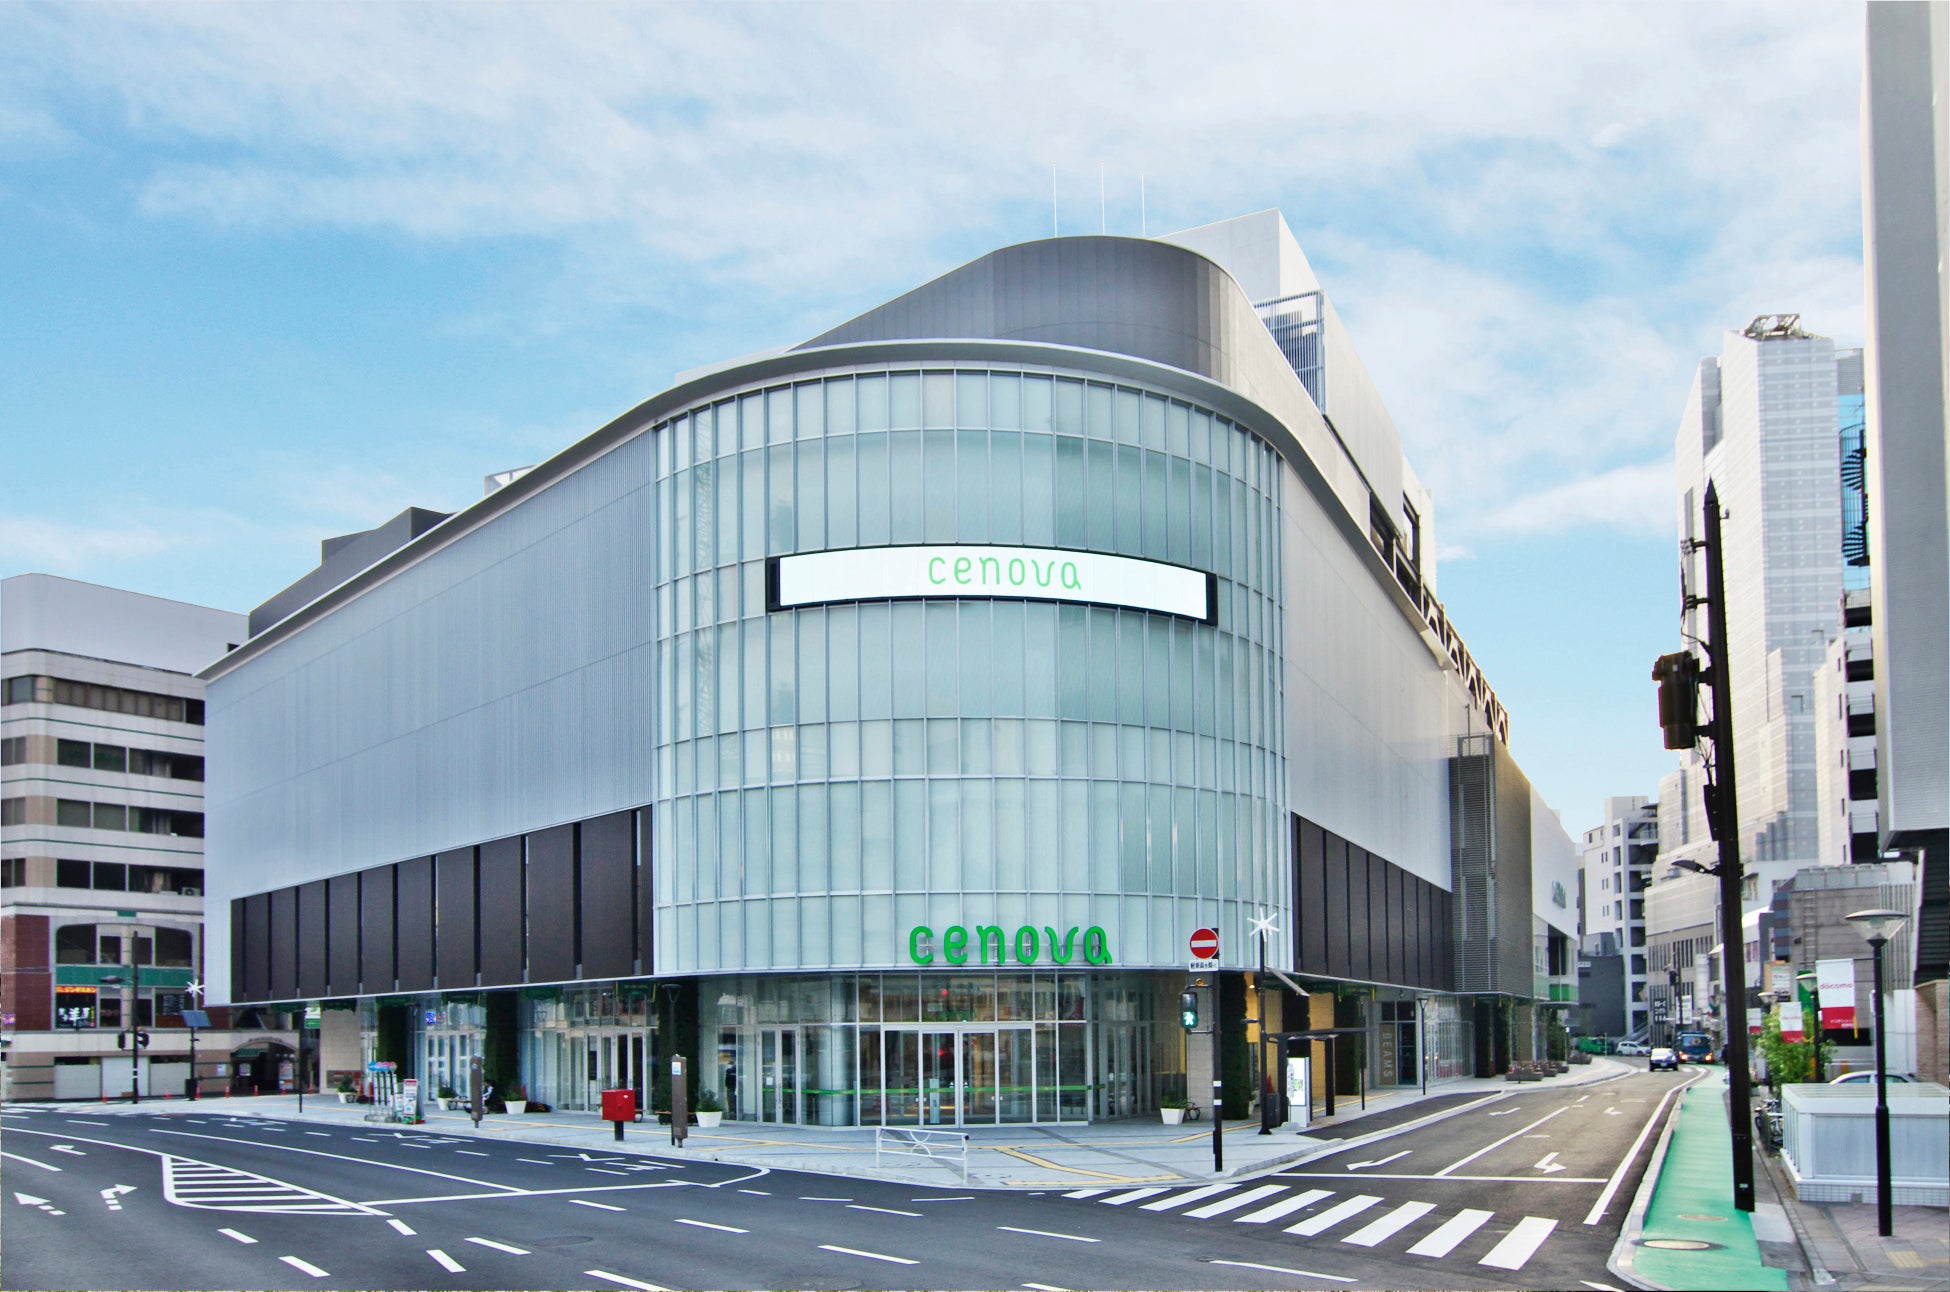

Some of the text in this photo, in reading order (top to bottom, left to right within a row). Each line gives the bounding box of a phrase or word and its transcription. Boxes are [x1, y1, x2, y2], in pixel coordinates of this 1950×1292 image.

[928, 556, 1081, 590] cenova
[909, 925, 1113, 965] cenova
[1383, 1033, 1393, 1077] BEAMS
